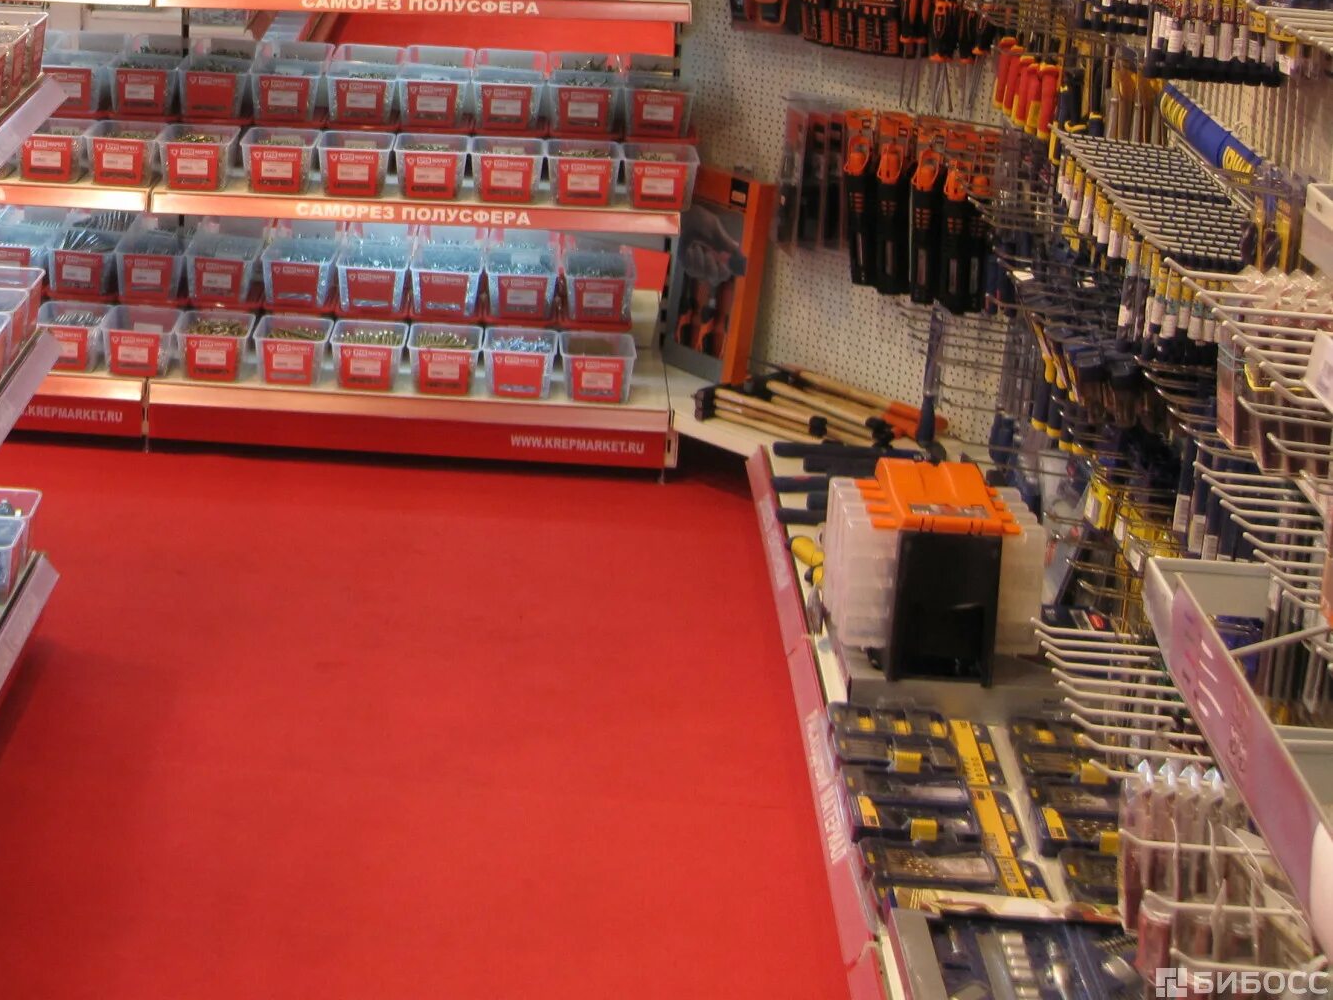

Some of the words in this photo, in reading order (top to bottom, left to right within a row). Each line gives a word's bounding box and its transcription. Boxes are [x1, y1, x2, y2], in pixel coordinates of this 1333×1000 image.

[295, 202, 395, 220] САМОРЕЗ
[401, 206, 531, 226] ПОЛУСФЕРА
[510, 434, 645, 454] WWW.KREPMARKET.RU
